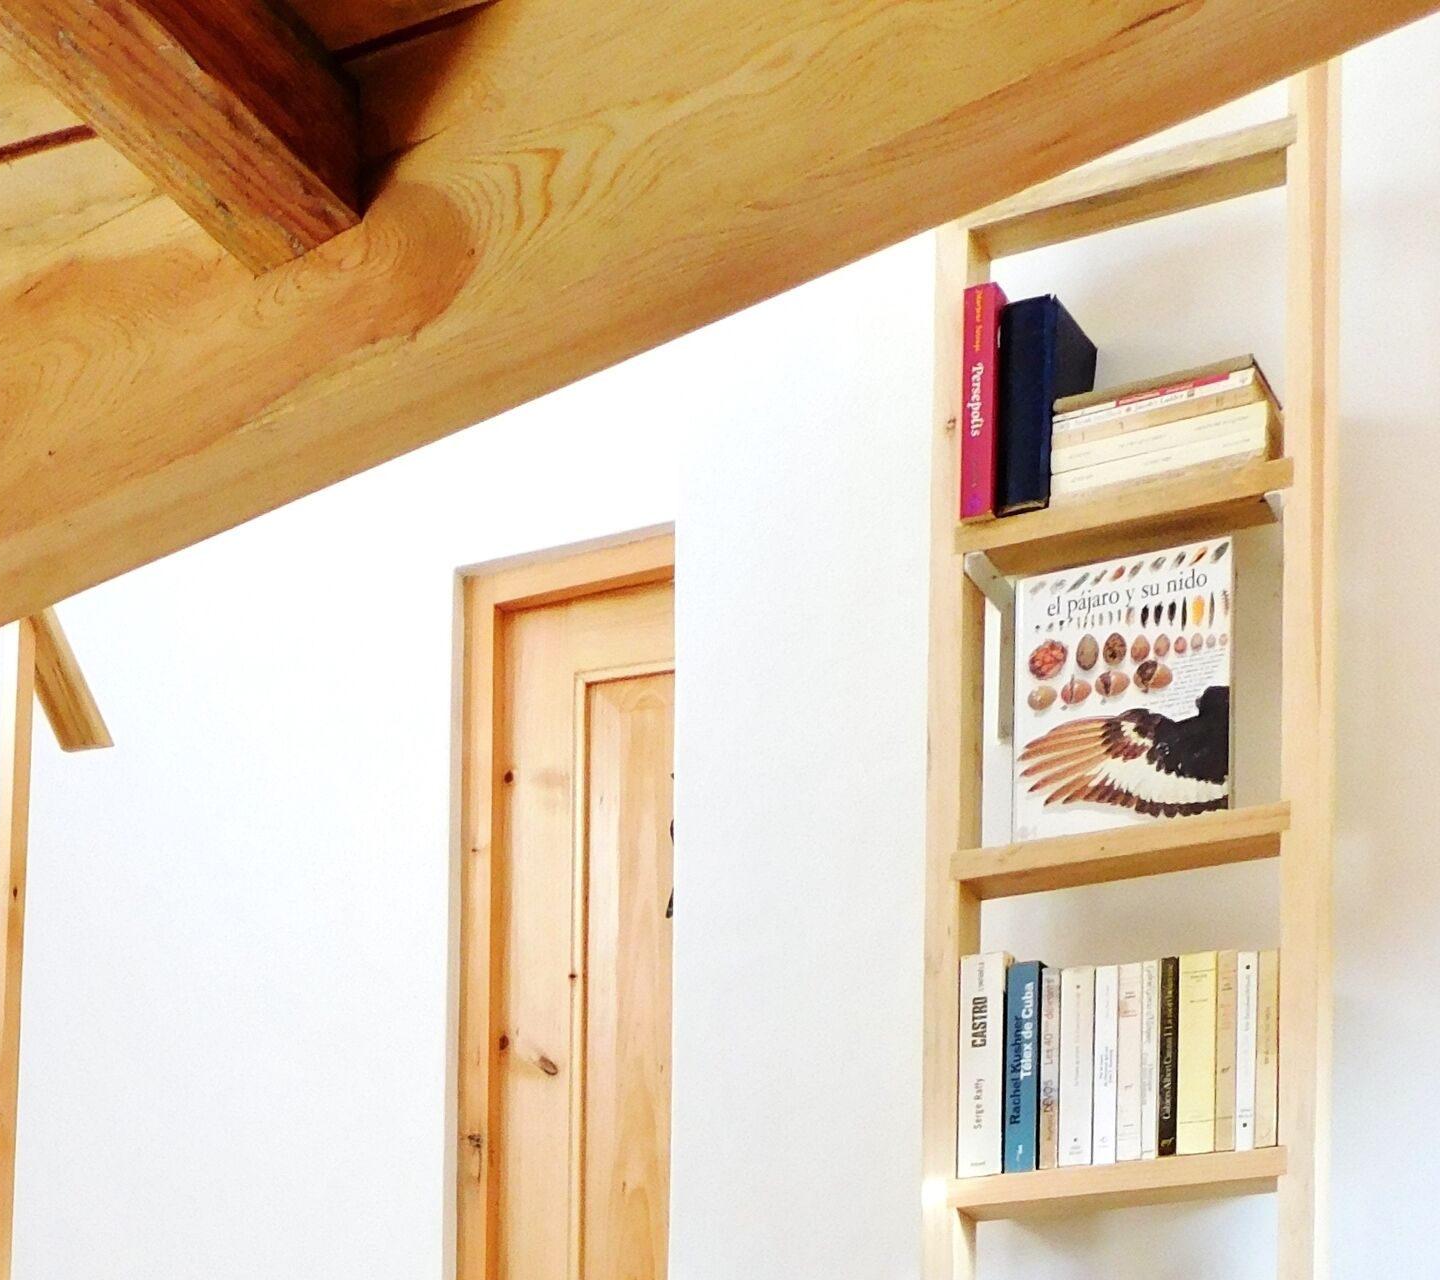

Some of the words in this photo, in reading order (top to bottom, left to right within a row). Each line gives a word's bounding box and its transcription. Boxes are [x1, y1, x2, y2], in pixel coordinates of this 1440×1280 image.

[966, 362, 986, 438] Persepolis
[1046, 599, 1061, 618] el
[1067, 587, 1120, 619] pájaro
[1126, 587, 1136, 603] y
[1140, 582, 1160, 600] su
[1166, 569, 1208, 594] nido
[971, 995, 989, 1048] CASTRO
[1021, 981, 1035, 1019] Cuba
[1009, 1015, 1023, 1074] Kushner
[1021, 1023, 1033, 1039] de
[1019, 1042, 1033, 1081] Télex
[973, 1077, 986, 1097] Raffy
[1009, 1077, 1021, 1125] Rachel
[972, 1100, 984, 1130] Serge
